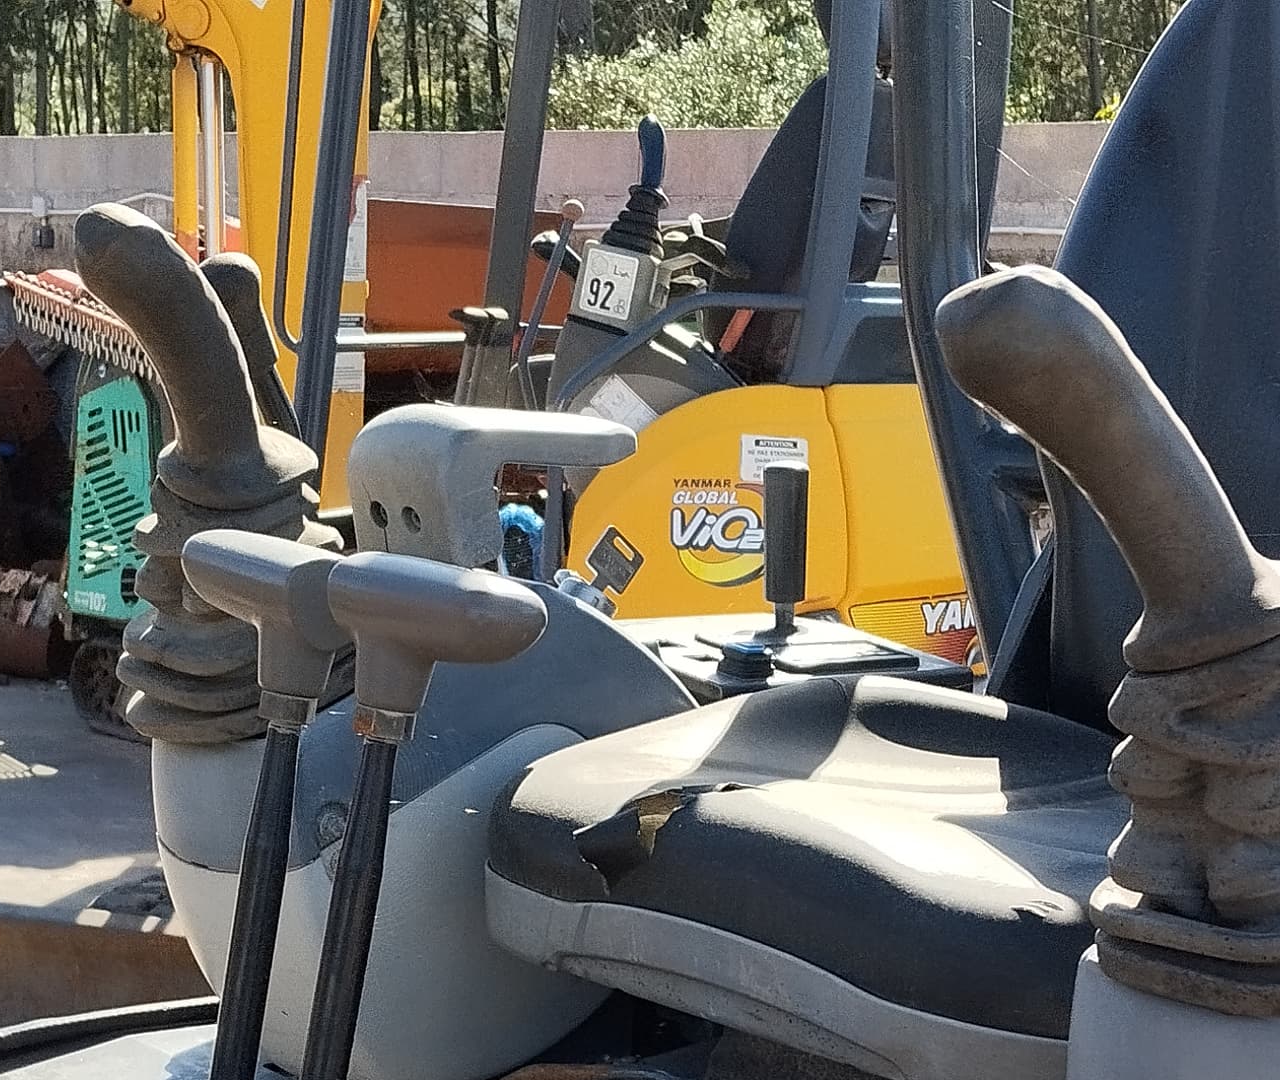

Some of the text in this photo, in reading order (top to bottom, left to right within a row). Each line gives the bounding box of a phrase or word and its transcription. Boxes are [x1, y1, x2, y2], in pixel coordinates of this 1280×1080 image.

[587, 278, 615, 310] 92
[673, 479, 732, 489] YANMAR
[673, 490, 738, 505] GLOBAL
[671, 507, 764, 552] ViO2
[921, 599, 976, 635] YAN
